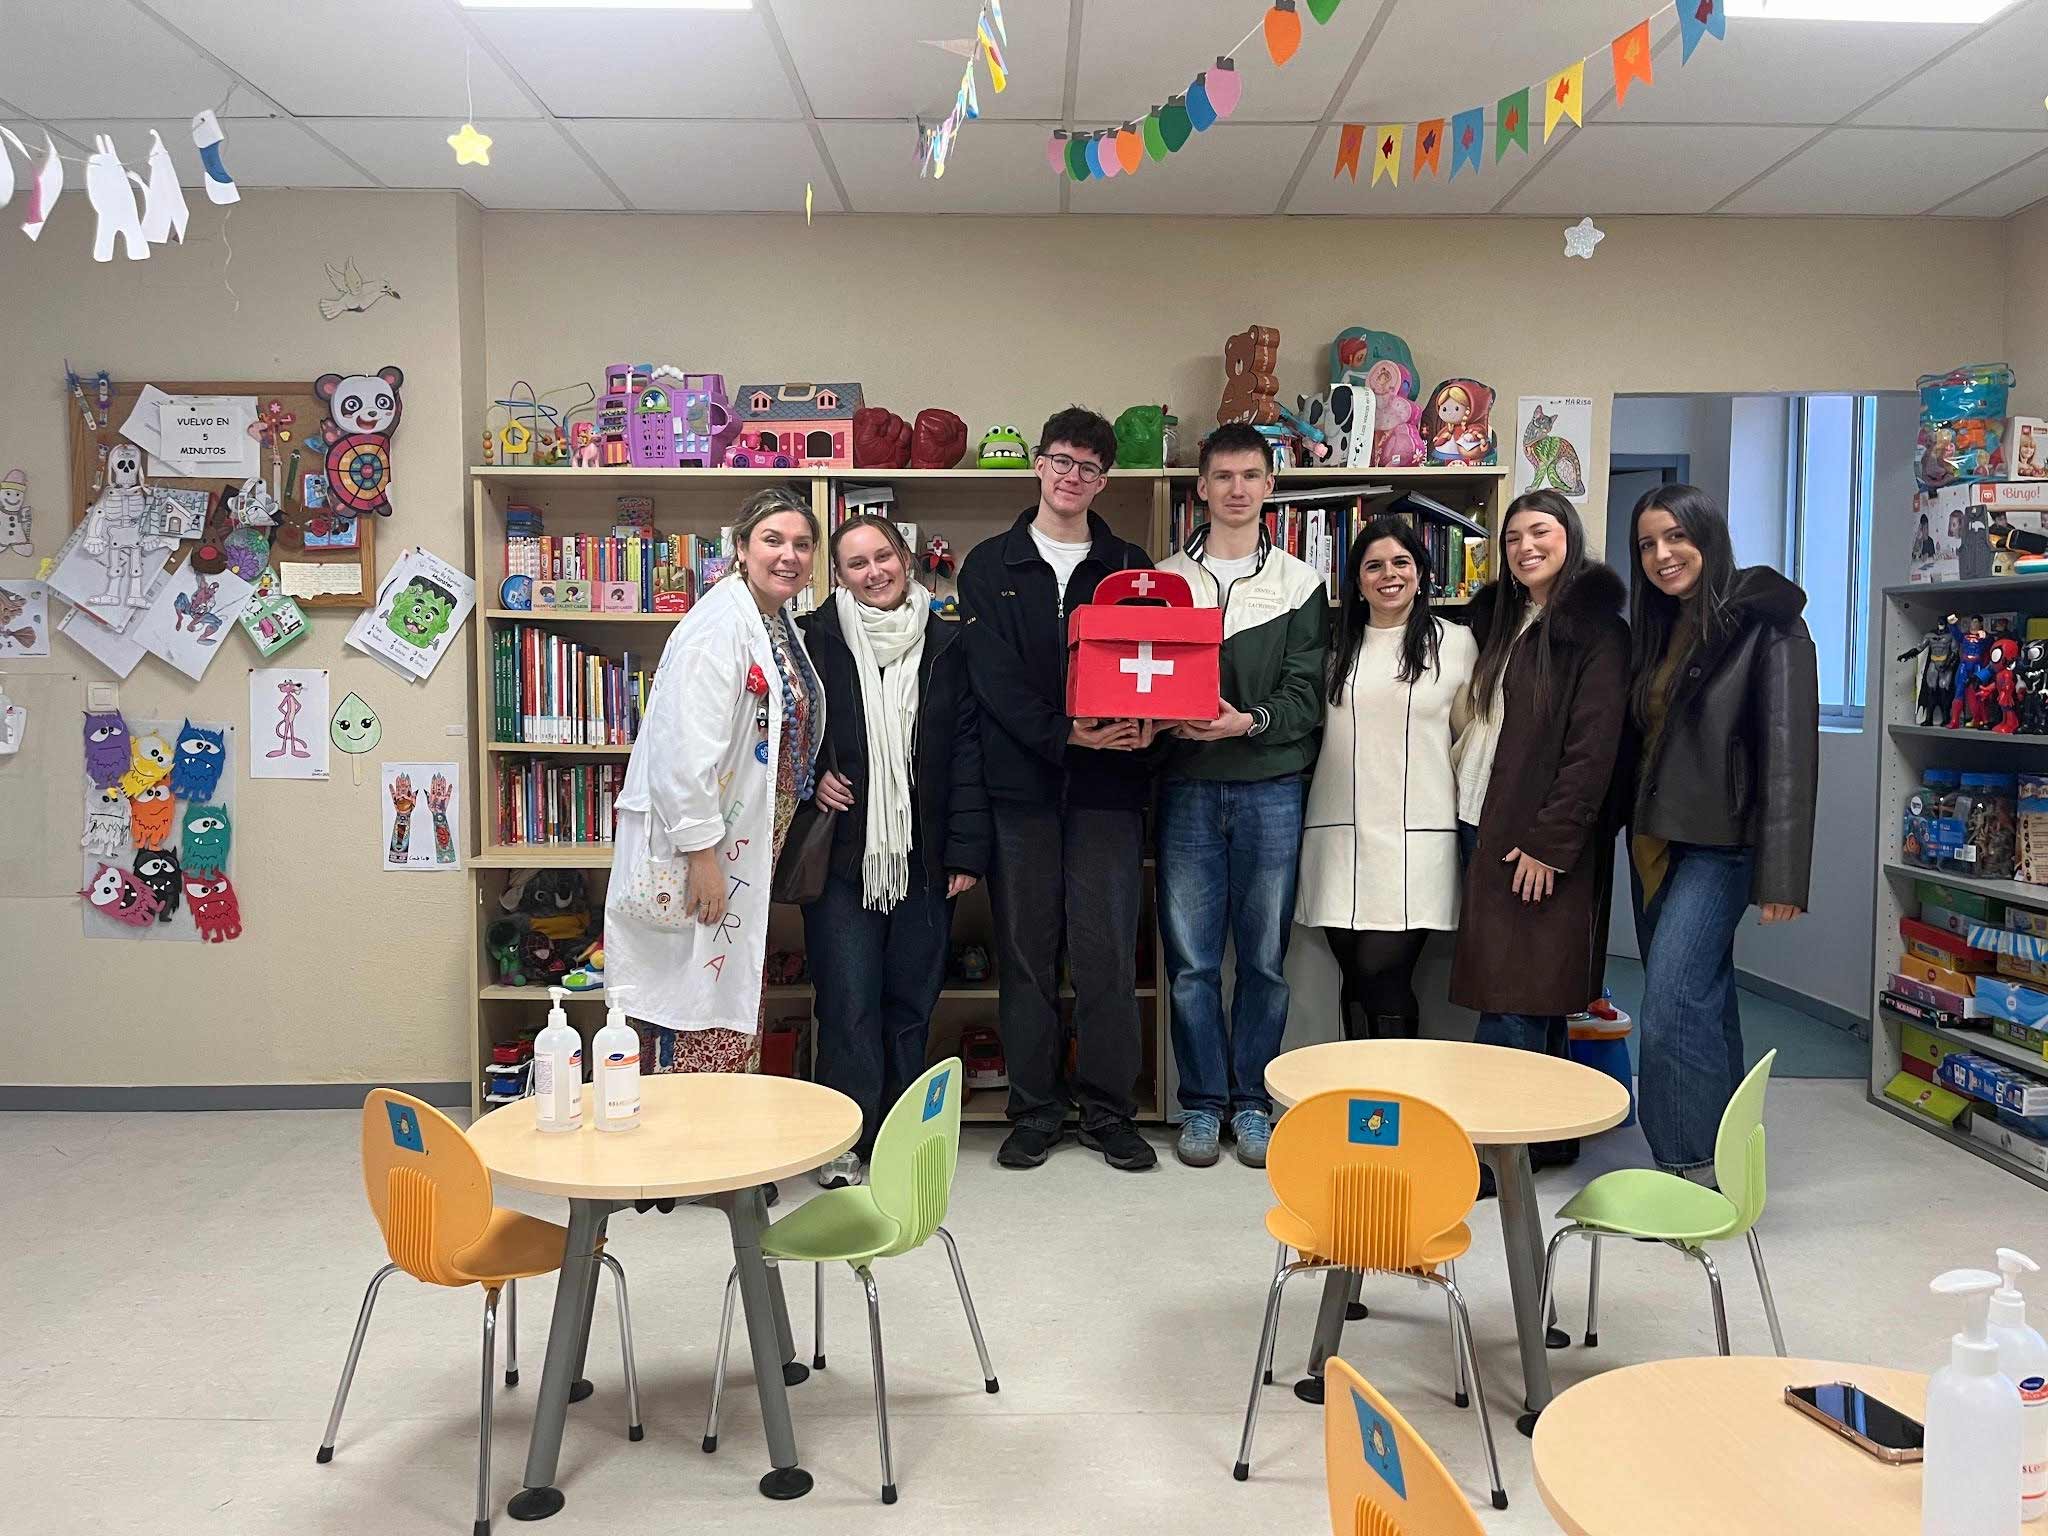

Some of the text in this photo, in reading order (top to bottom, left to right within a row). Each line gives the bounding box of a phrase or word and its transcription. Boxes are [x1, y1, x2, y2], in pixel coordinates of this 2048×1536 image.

[177, 418, 230, 426] VUELVO EN
[203, 433, 209, 441] 5
[180, 447, 226, 455] MINUTOS
[2002, 486, 2041, 500] Bingo!
[432, 573, 453, 589] Monster
